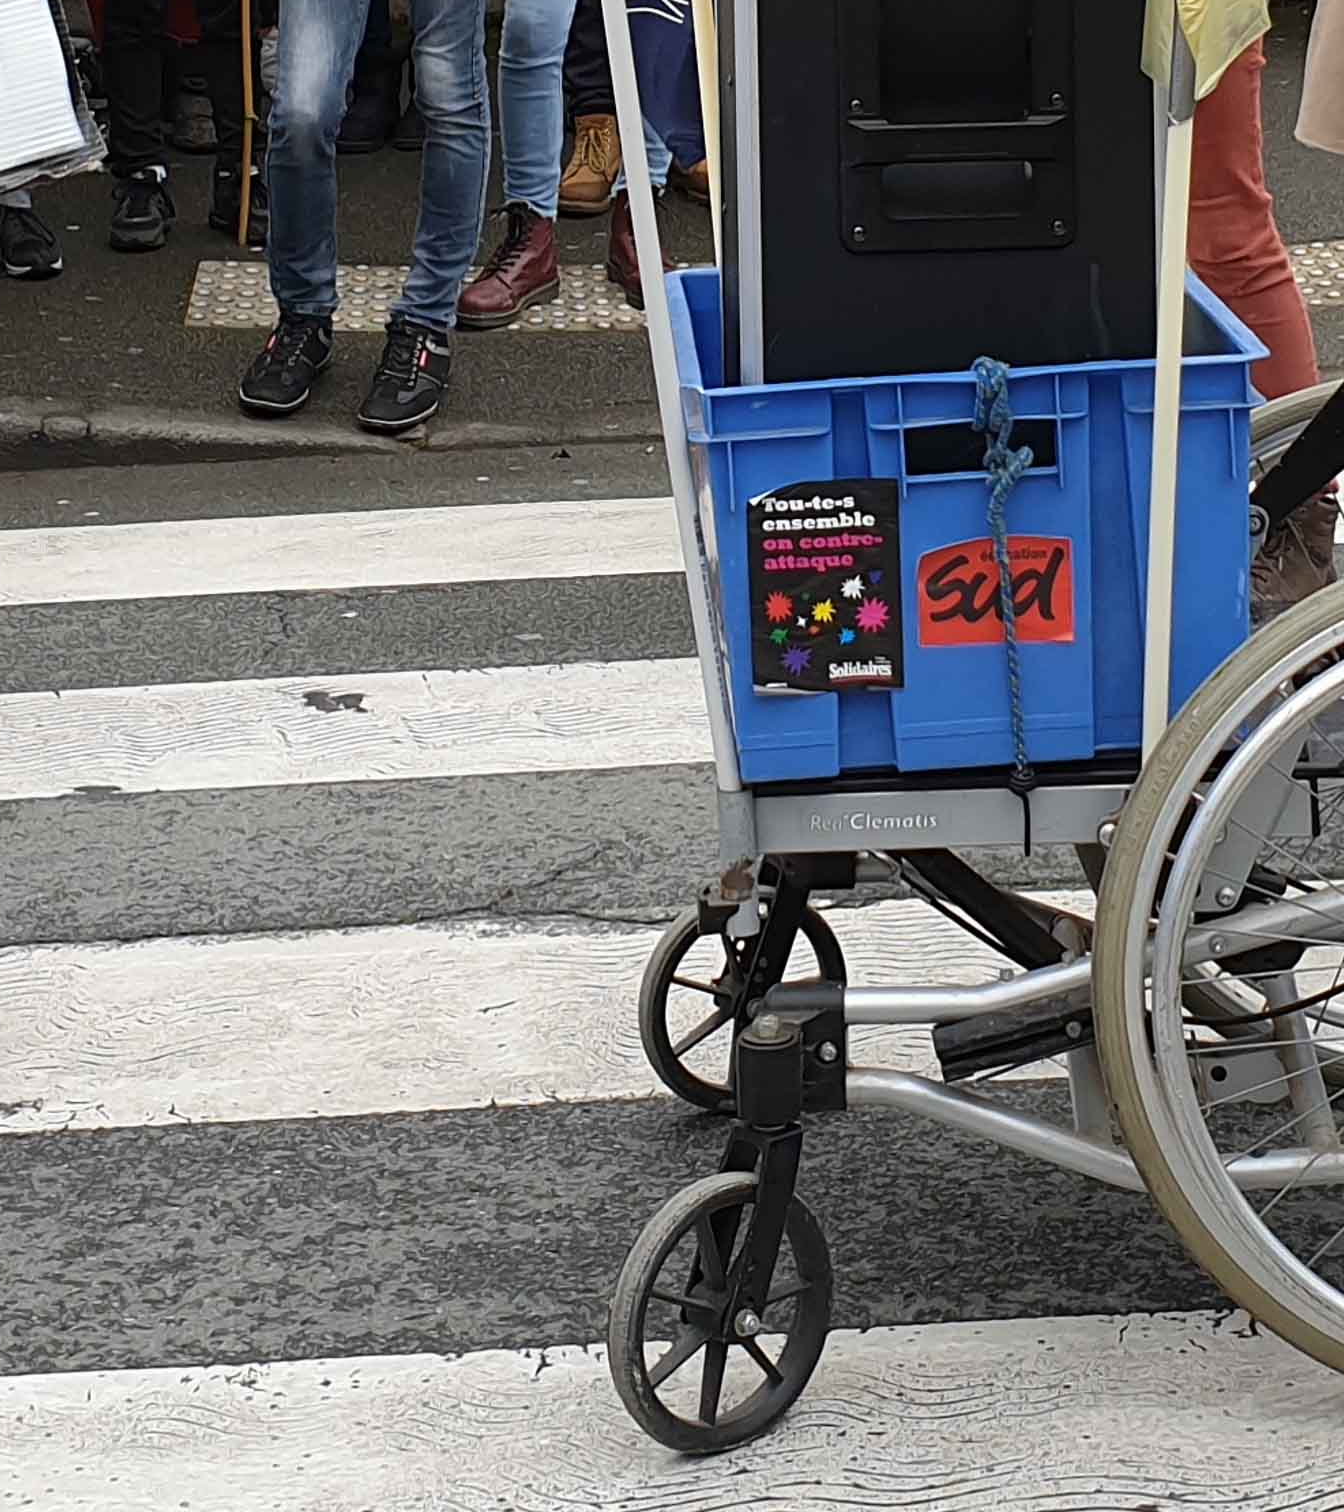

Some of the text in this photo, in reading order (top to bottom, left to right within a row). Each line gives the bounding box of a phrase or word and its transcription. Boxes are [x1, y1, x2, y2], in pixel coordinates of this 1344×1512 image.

[762, 511, 876, 532] ensemble
[762, 538, 794, 551] on
[980, 545, 1048, 562] édcation
[763, 552, 855, 572] attaque
[828, 660, 893, 679] Solidaires
